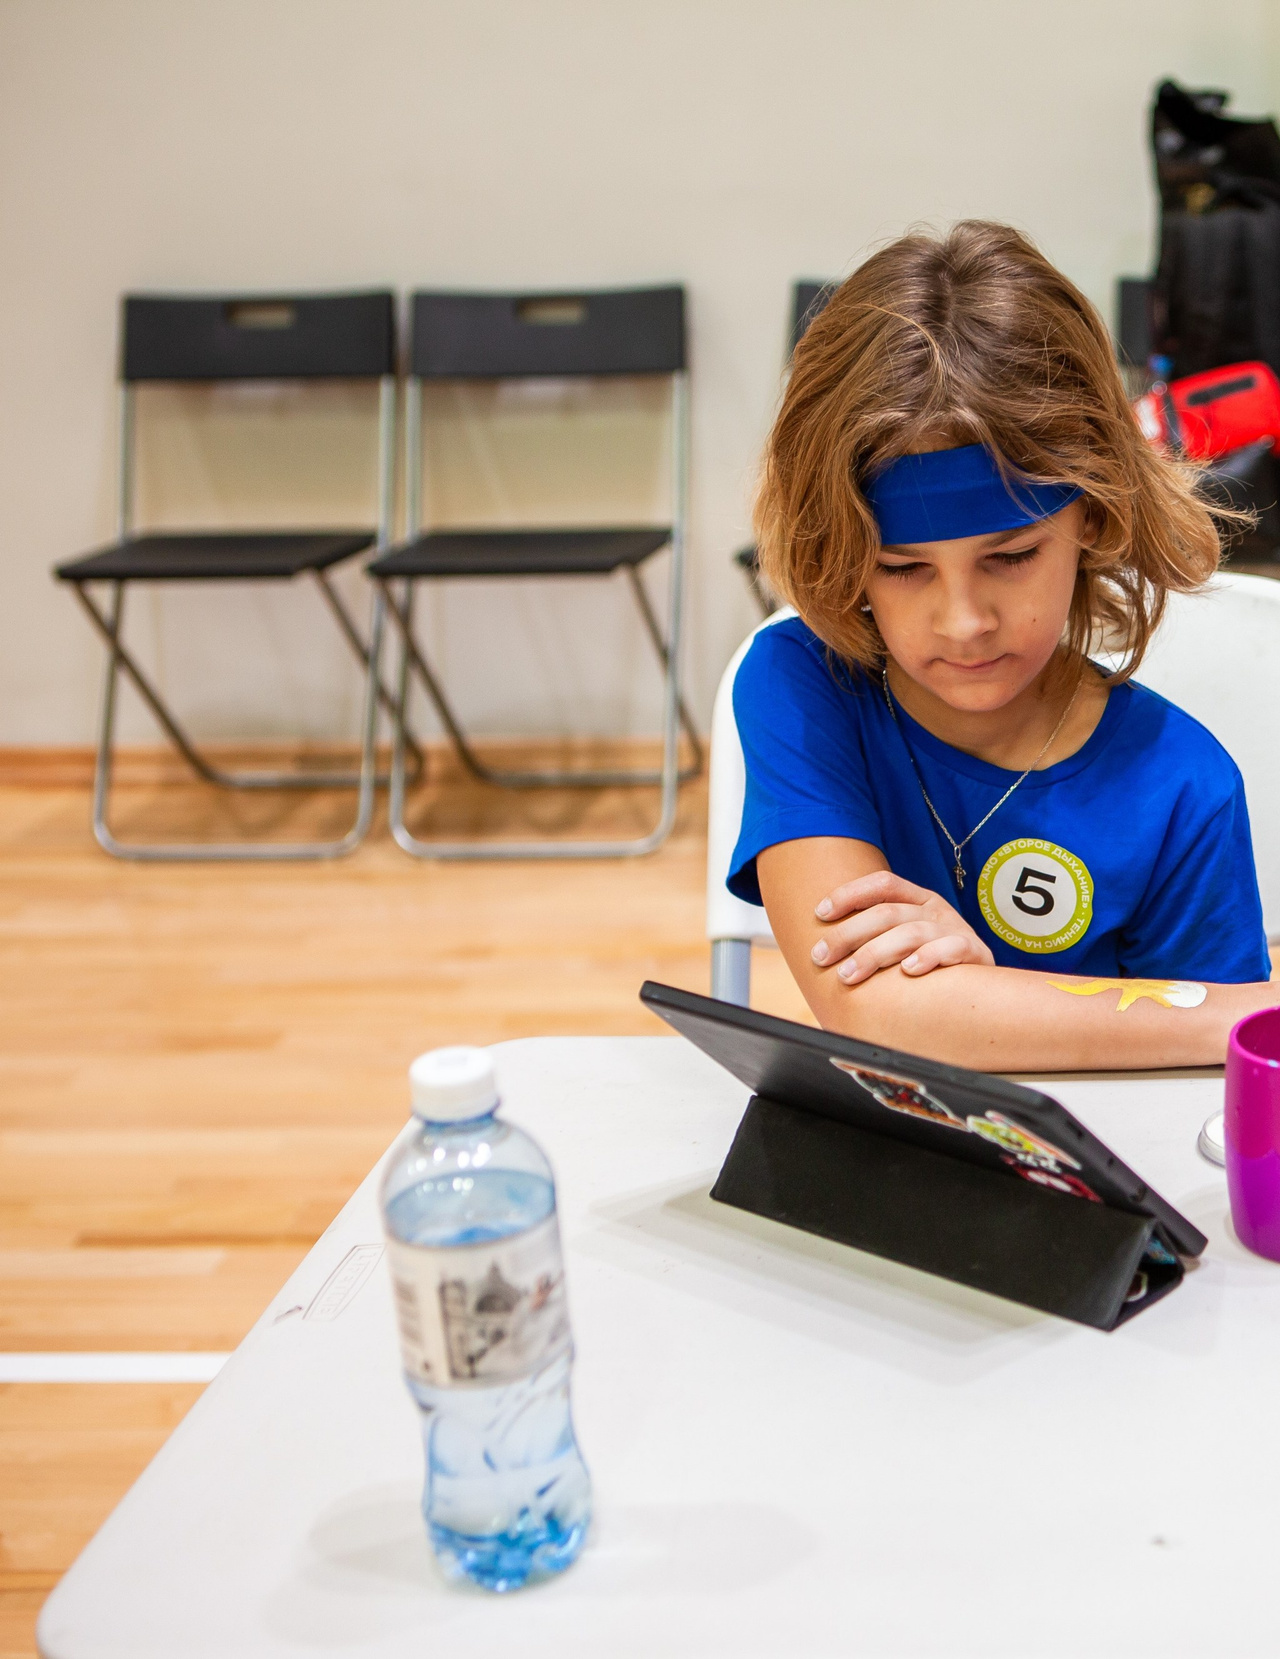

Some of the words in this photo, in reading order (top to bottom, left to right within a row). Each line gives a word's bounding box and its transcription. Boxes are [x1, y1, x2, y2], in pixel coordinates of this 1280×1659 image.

[982, 858, 998, 880] АНО
[998, 840, 1051, 857] «ВТОРОЕ
[1052, 848, 1089, 908] ДЫХАНИЕ»
[1011, 866, 1057, 917] 5
[980, 889, 1022, 944] КОЛЯСКАХ
[1045, 918, 1085, 948] ТЕННИС
[1025, 940, 1042, 949] НА
